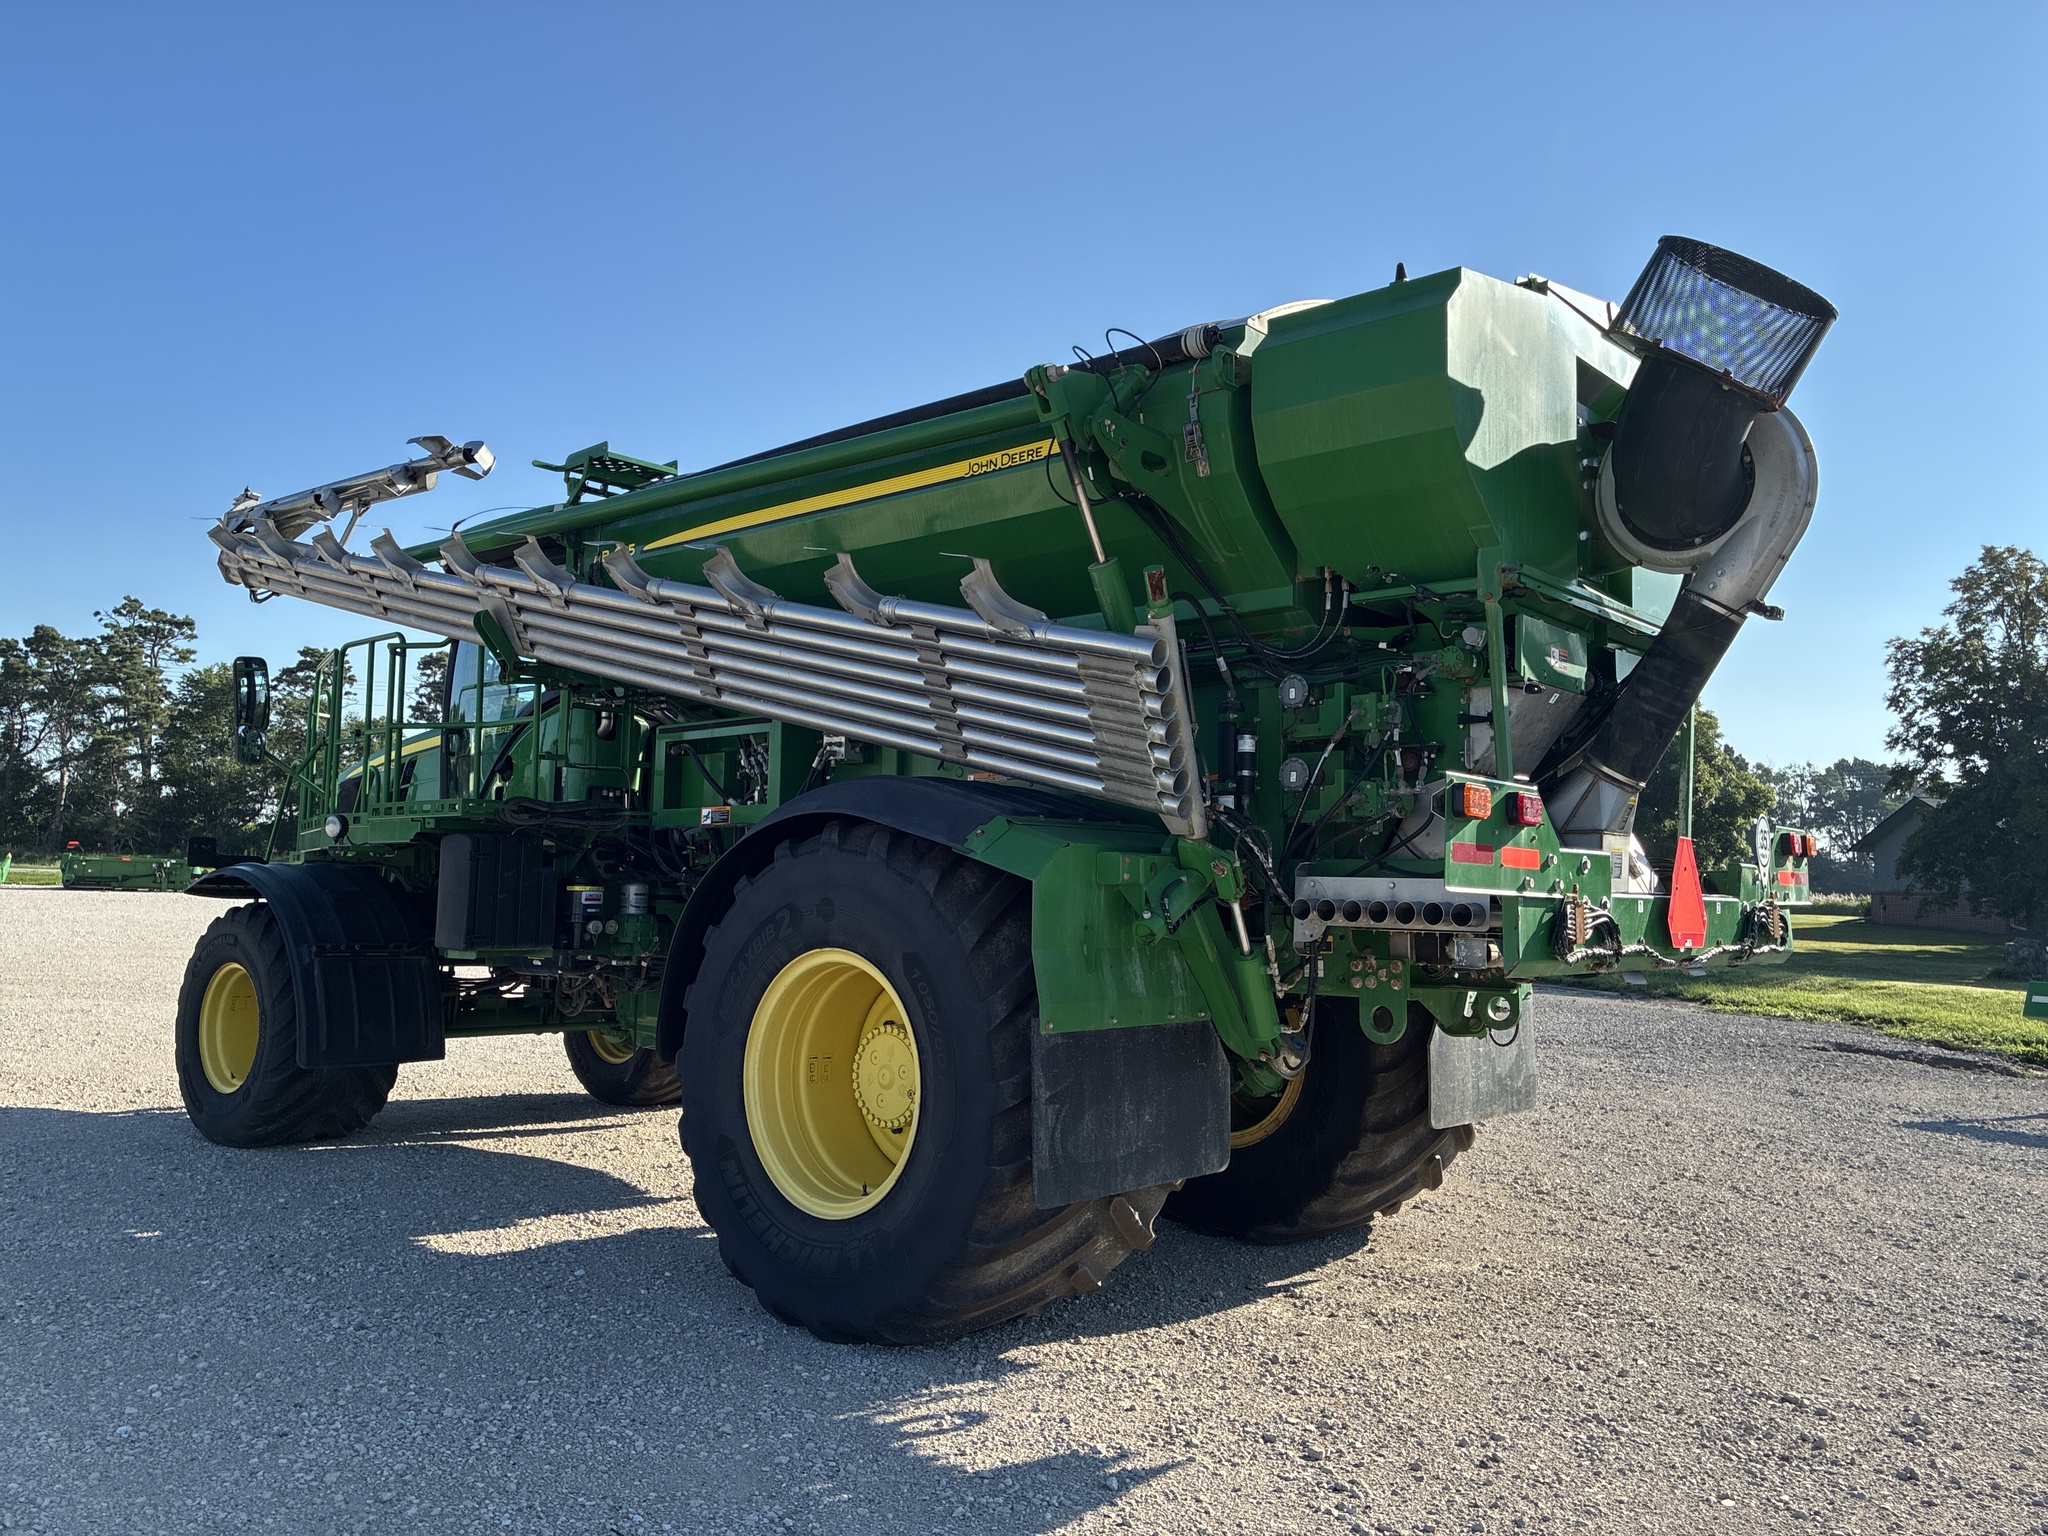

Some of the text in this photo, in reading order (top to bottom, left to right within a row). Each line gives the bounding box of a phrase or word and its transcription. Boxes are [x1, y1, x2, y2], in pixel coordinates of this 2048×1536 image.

[964, 446, 1044, 476] JOHN DEERE
[200, 934, 236, 962] MICHELIN
[717, 907, 793, 1022] MEGAXBIB 2
[910, 967, 948, 1069] 1050/50
[717, 1159, 841, 1272] MICHELIN
